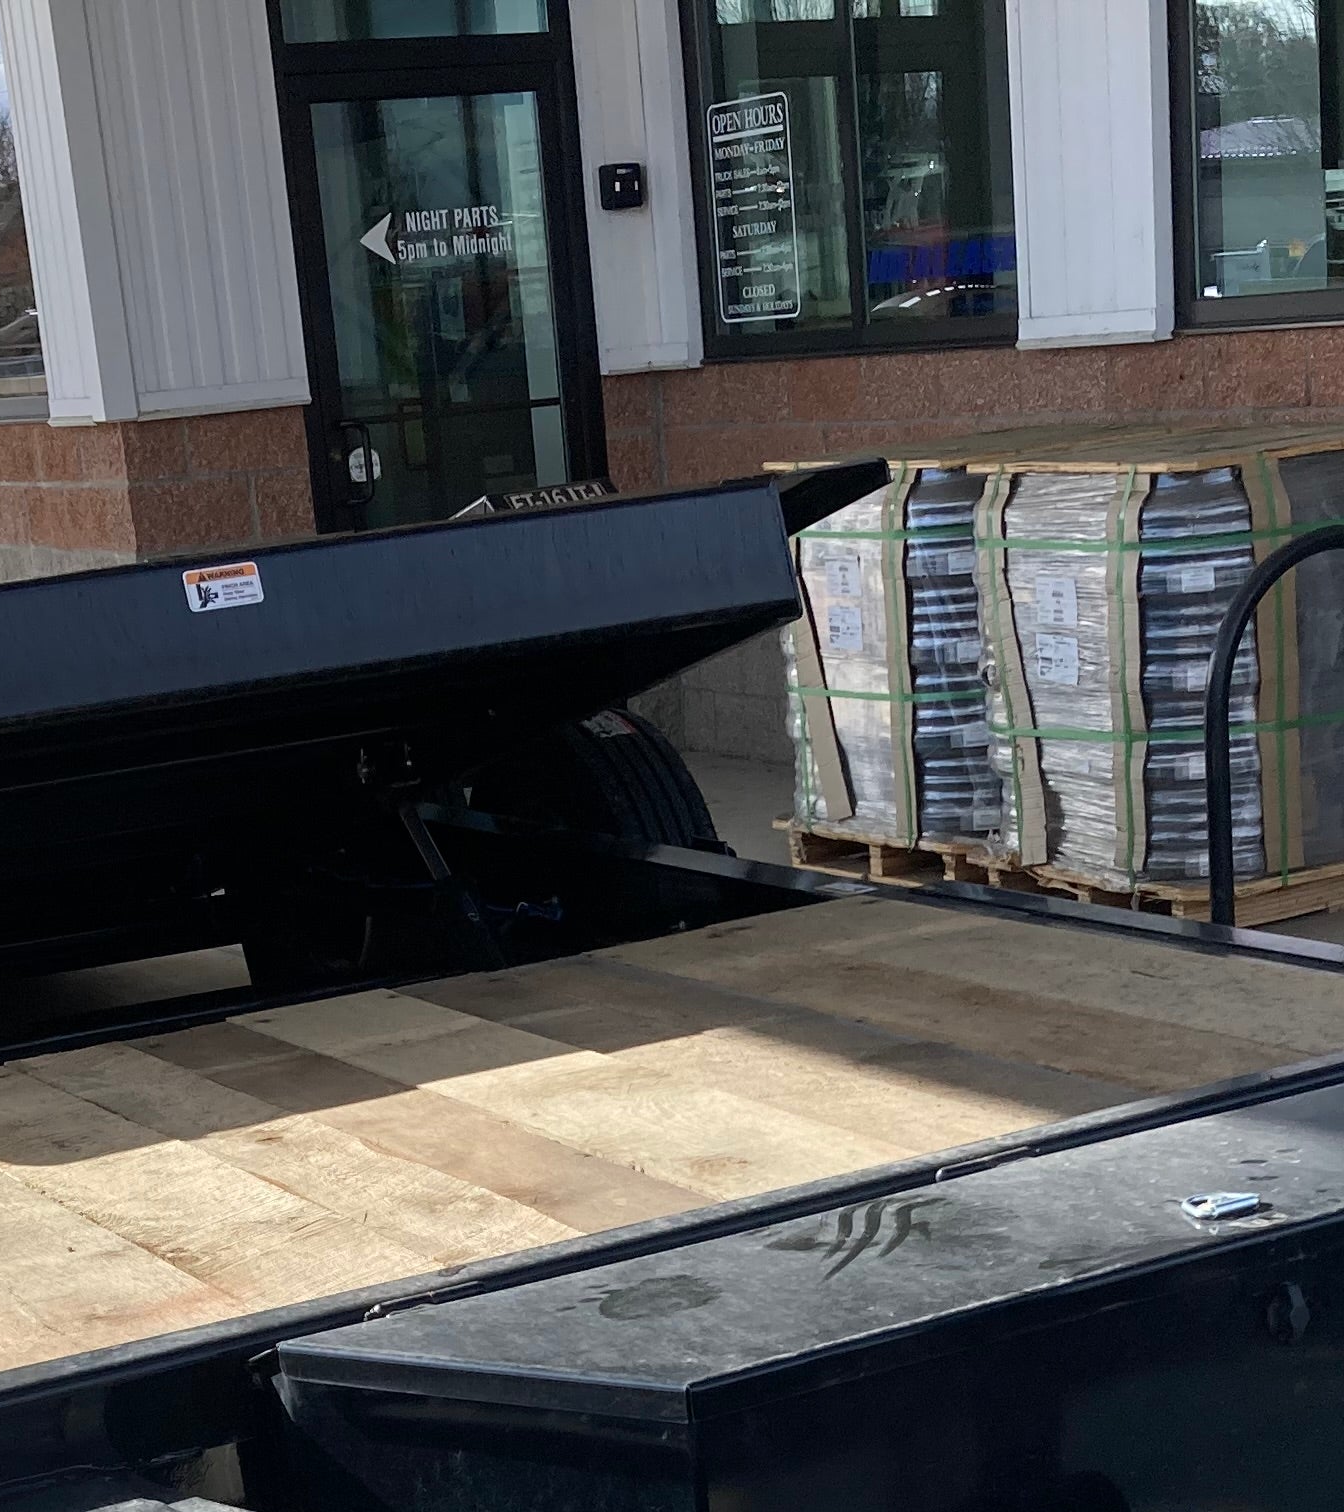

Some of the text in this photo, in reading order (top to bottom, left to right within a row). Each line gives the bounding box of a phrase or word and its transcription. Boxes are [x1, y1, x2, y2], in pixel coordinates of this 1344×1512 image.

[712, 103, 784, 134] OPEN HOURS
[406, 205, 499, 232] NIGHT PARTS
[733, 221, 776, 238] SATURDAY
[397, 231, 513, 262] 5pm to Midnight
[743, 284, 775, 298] CLOSED
